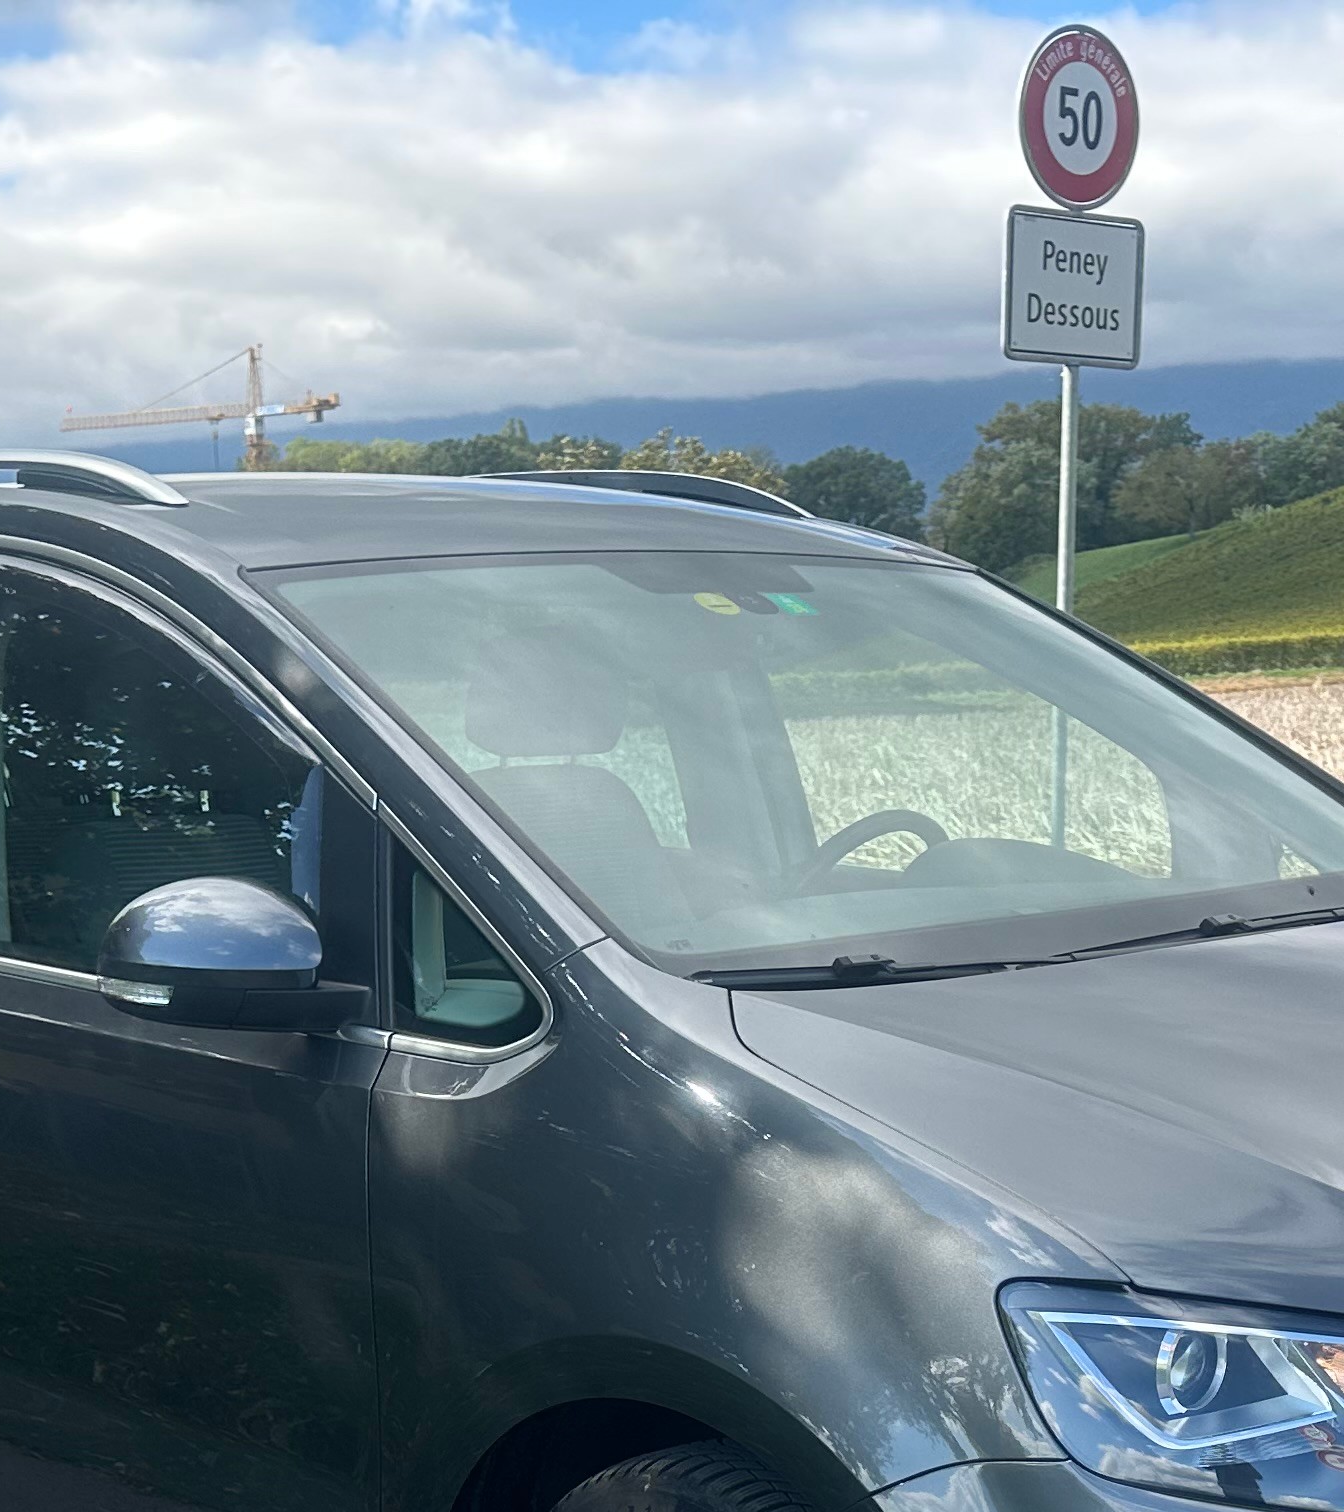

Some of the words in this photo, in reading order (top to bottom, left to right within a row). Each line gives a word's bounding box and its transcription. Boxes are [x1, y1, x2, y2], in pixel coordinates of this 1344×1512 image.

[1035, 41, 1074, 81] Limite
[1079, 39, 1127, 98] générale
[1058, 85, 1103, 150] 50
[1042, 239, 1109, 285] Peney
[1027, 292, 1120, 331] Dessous
